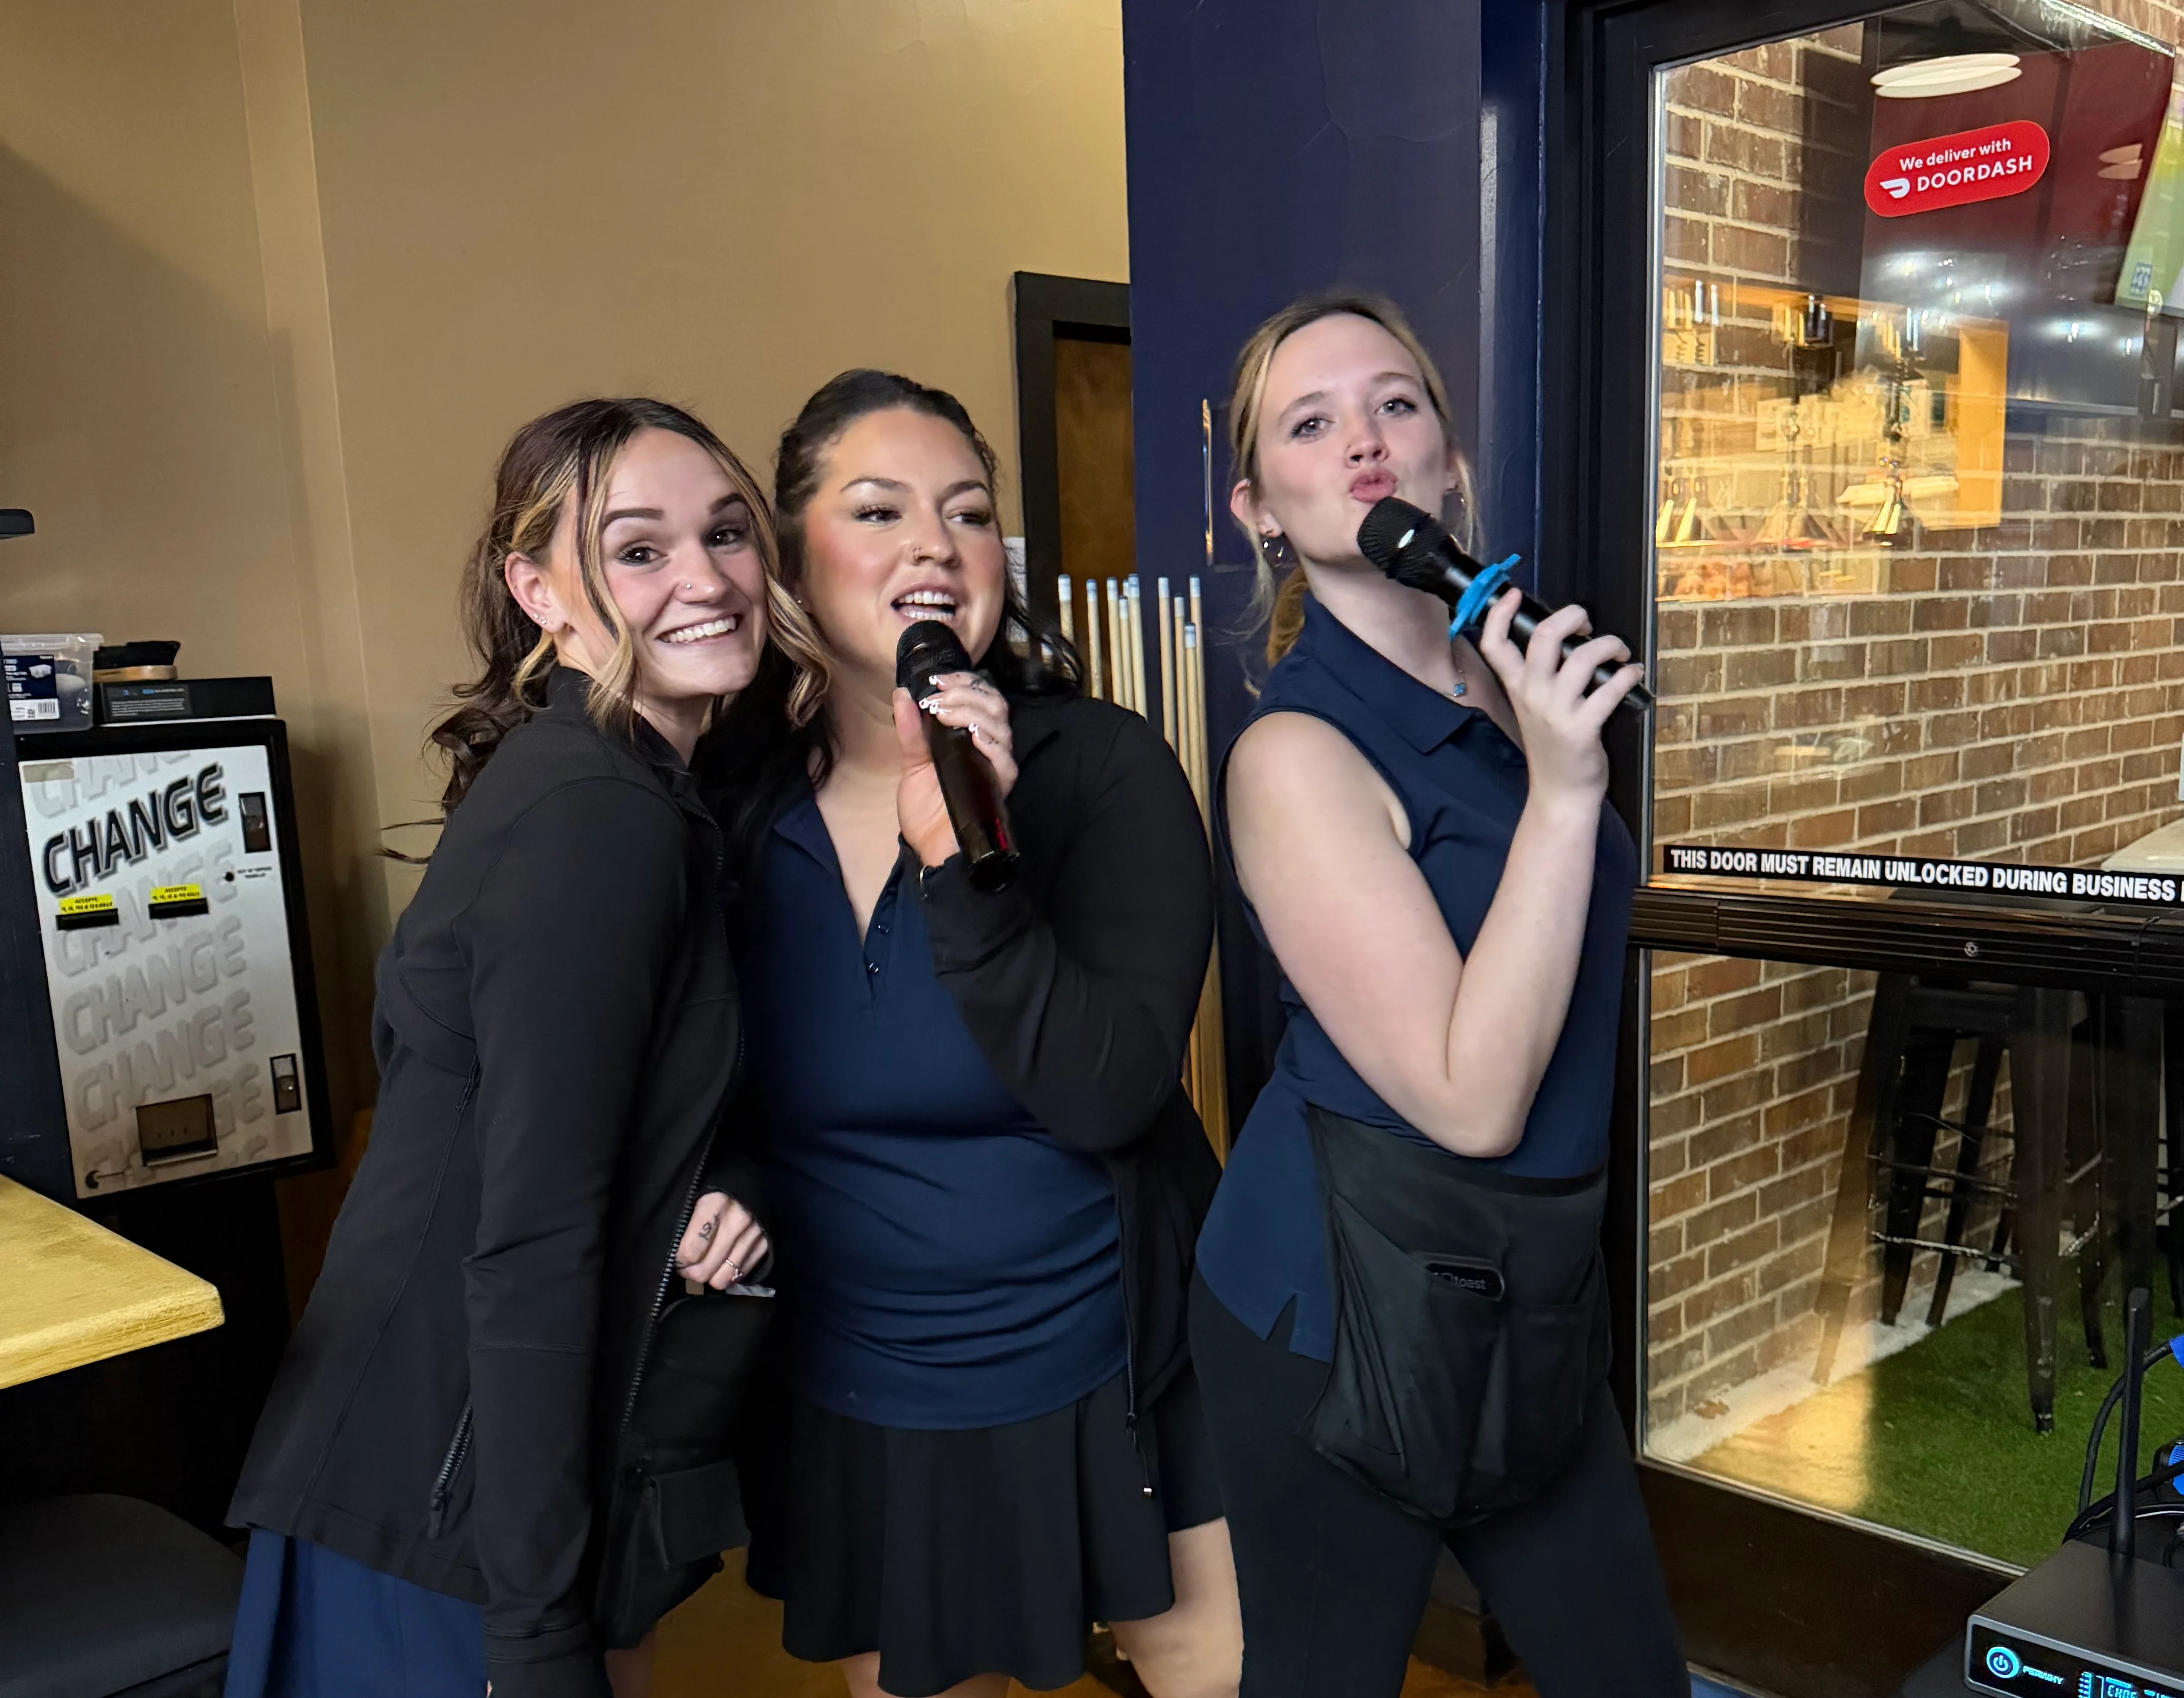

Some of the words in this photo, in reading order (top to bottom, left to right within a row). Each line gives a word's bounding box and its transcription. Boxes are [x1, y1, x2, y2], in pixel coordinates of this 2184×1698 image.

[1899, 156, 1923, 172] We
[1926, 147, 1977, 166] deliver
[1979, 138, 2011, 156] with
[1917, 155, 2033, 192] DOORDASH
[42, 762, 227, 896] CHANGE
[1670, 849, 1707, 869] THIS
[1710, 851, 1758, 872] DOOR
[1760, 853, 1809, 875] MUST
[1812, 856, 1881, 880] REMAIN
[1884, 860, 1989, 887] UNLOCKED
[1992, 868, 2067, 894] DURING
[2072, 873, 2176, 901] BUSINESS
[63, 915, 247, 1056] CHANGE
[72, 988, 255, 1132] CHANGE
